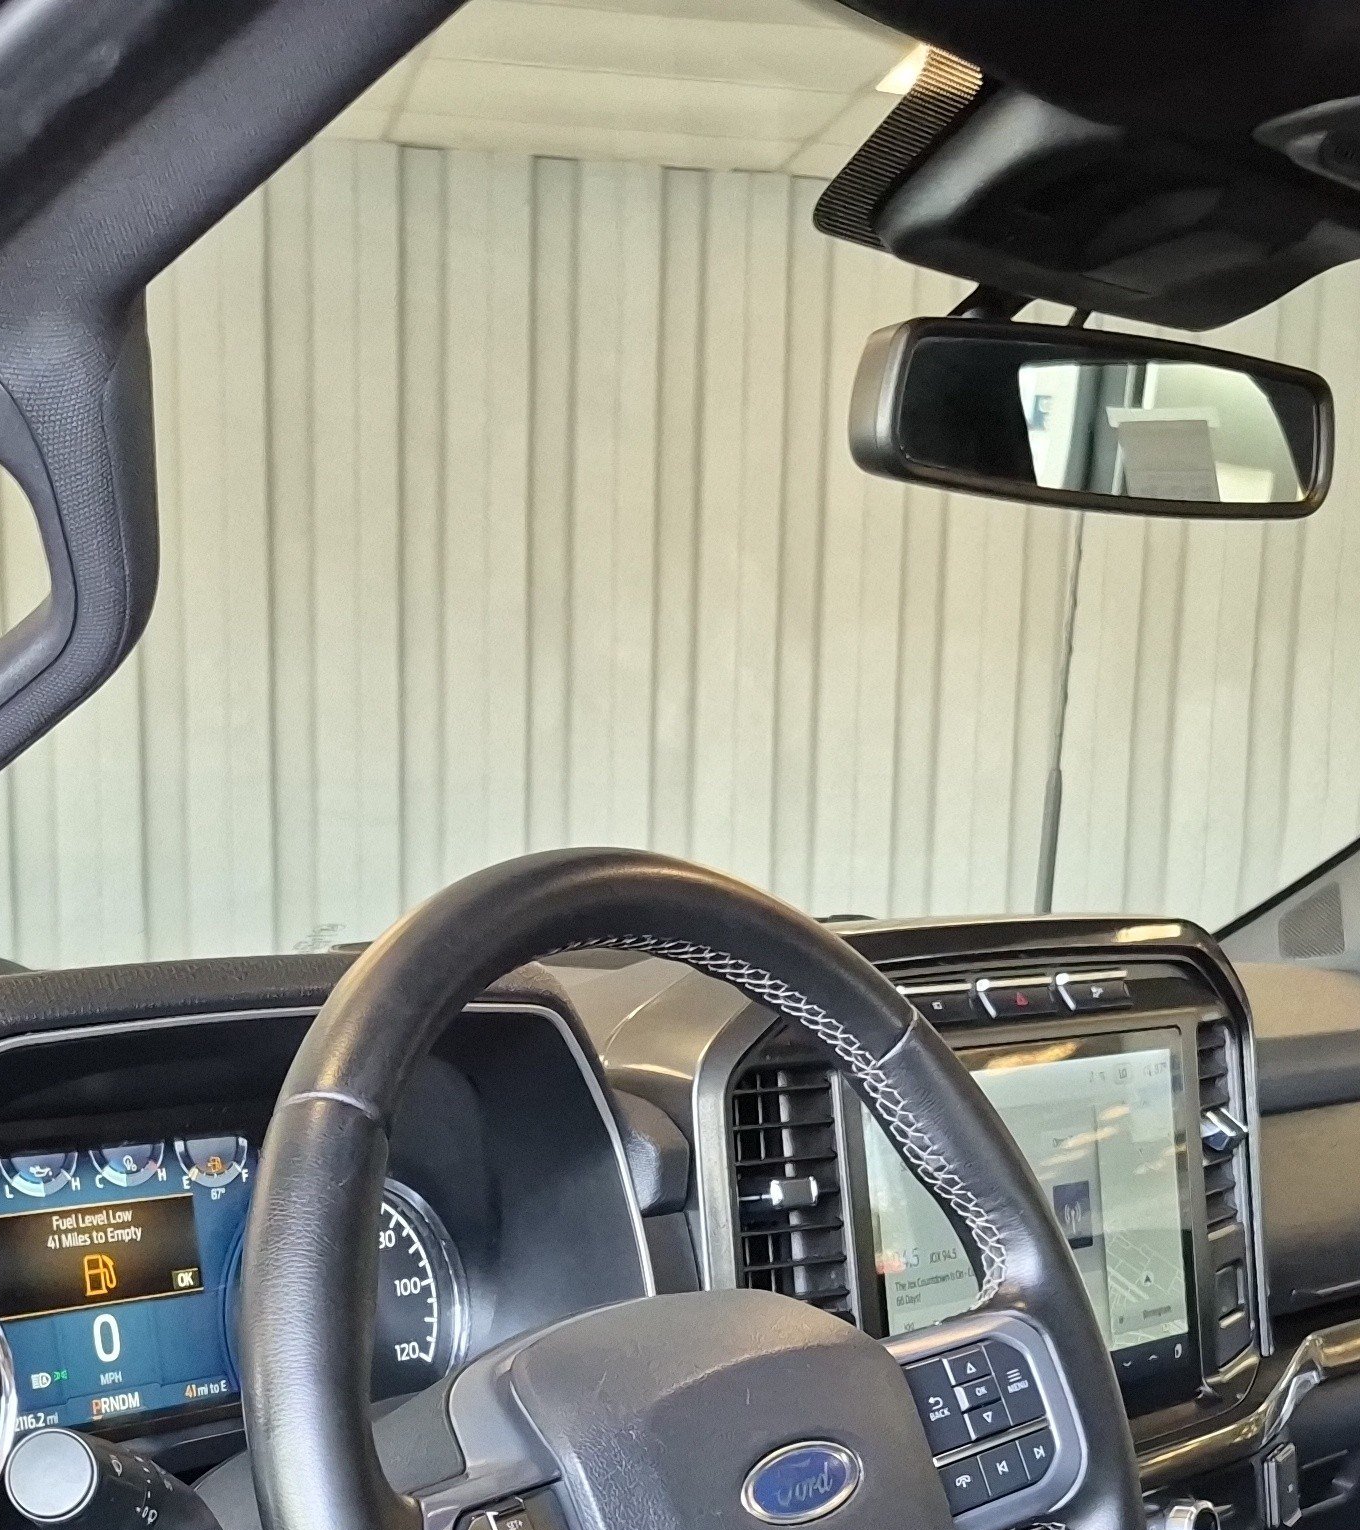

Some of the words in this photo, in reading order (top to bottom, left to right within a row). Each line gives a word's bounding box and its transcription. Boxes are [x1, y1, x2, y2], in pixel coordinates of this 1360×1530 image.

[95, 1175, 104, 1189] C
[158, 1168, 167, 1181] H
[241, 1169, 249, 1183] F
[70, 1177, 81, 1191] H
[182, 1176, 191, 1190] E
[4, 1185, 14, 1199] L
[52, 1212, 77, 1231] Fuel
[79, 1209, 108, 1228] Level
[109, 1207, 133, 1225] Low
[47, 1235, 60, 1250] 41
[62, 1230, 91, 1249] Miles
[93, 1229, 106, 1245] to
[107, 1225, 142, 1244] Empty
[177, 1270, 194, 1287] OK
[394, 1277, 421, 1297] 100
[92, 1313, 121, 1363] 0
[394, 1341, 419, 1361] 120
[100, 1371, 123, 1386] MPH
[184, 1384, 197, 1398] 41
[197, 1383, 209, 1398] mi
[210, 1382, 220, 1395] to
[220, 1380, 227, 1393] E
[975, 1385, 988, 1397] OK
[1007, 1379, 1029, 1394] MENU
[46, 1411, 59, 1426] mi
[929, 1407, 951, 1422] BACK
